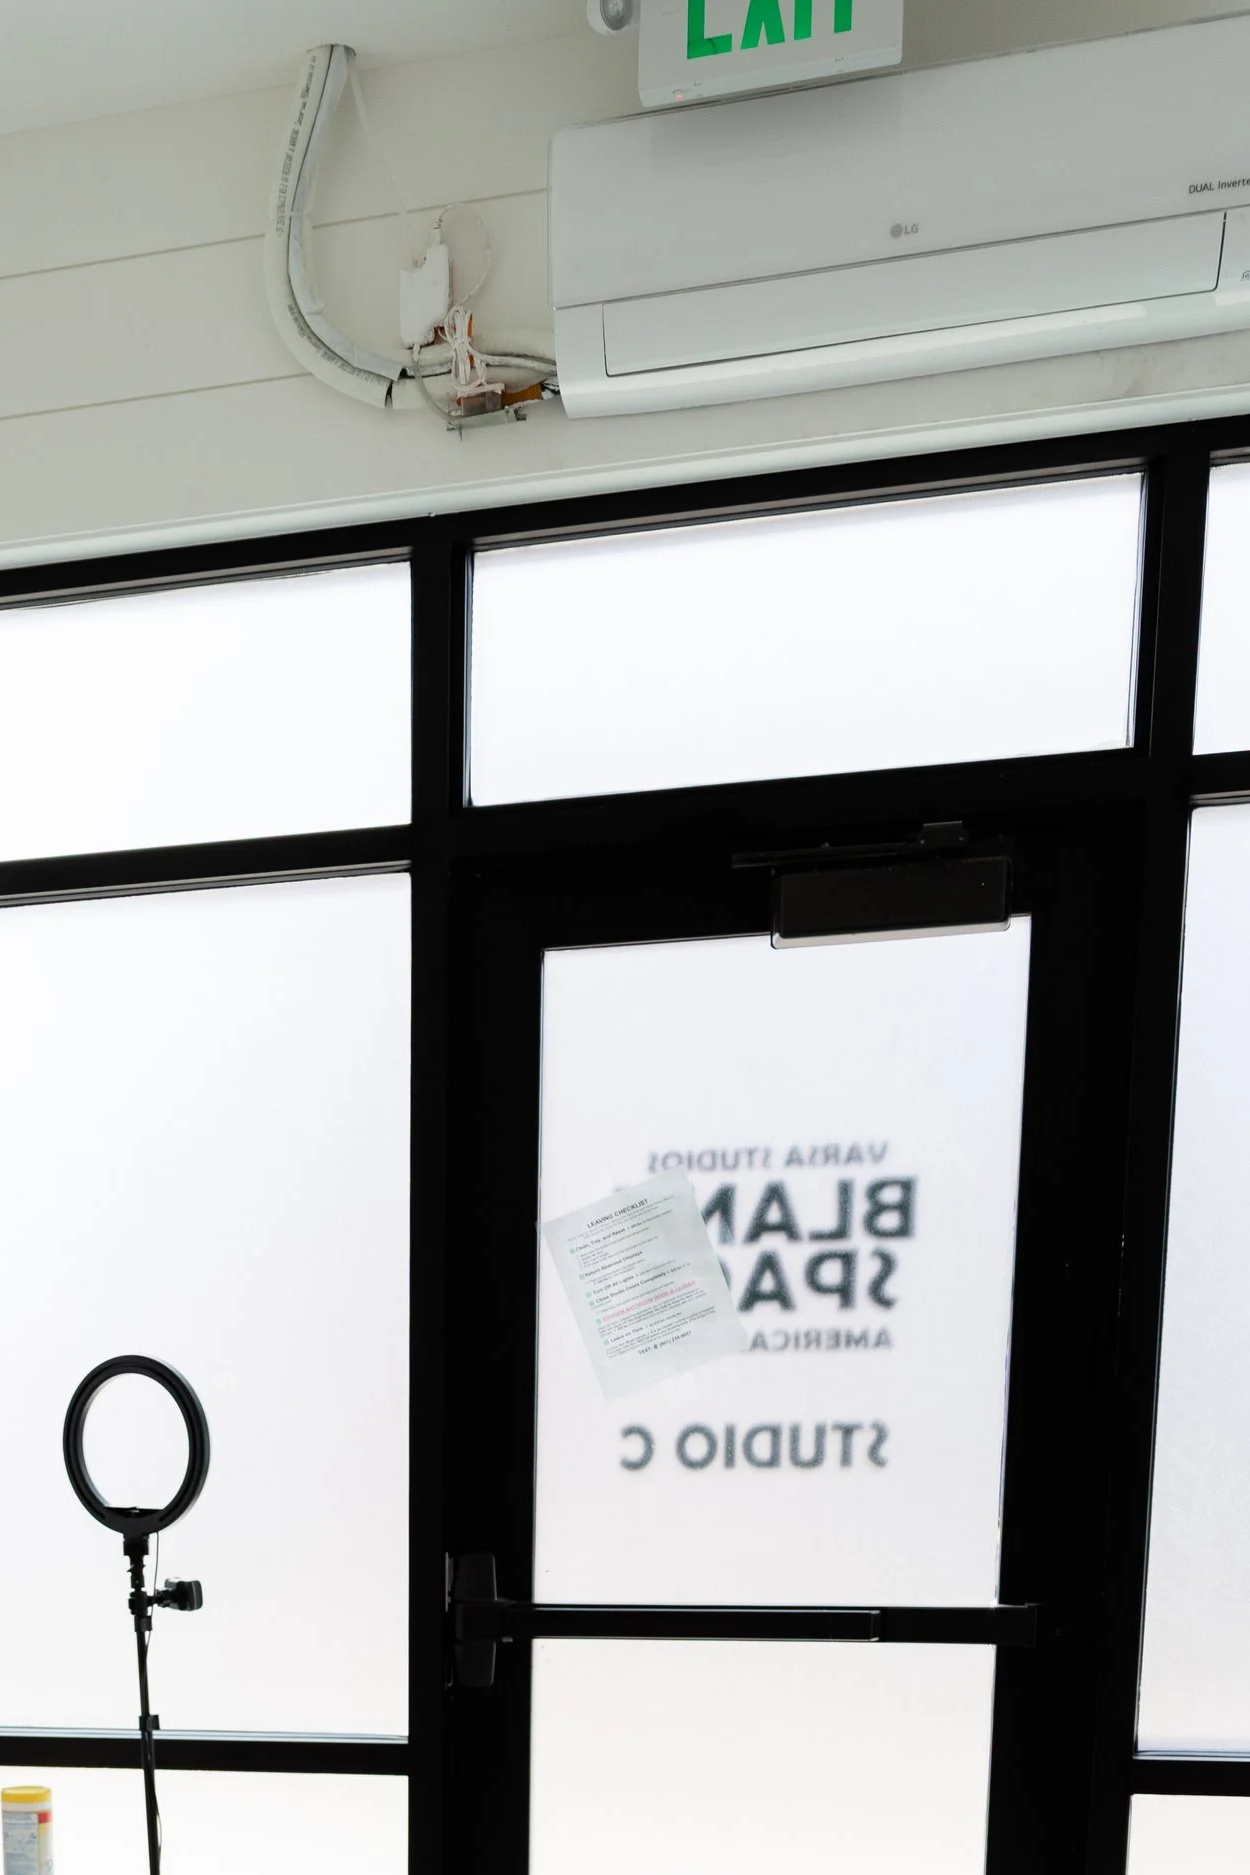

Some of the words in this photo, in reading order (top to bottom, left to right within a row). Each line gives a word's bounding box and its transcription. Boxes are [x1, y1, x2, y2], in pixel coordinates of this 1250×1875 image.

[1188, 182, 1214, 194] DUAL
[904, 223, 919, 235] LG
[586, 1213, 614, 1229] LEAVING
[613, 1198, 649, 1217] CHECKLIST
